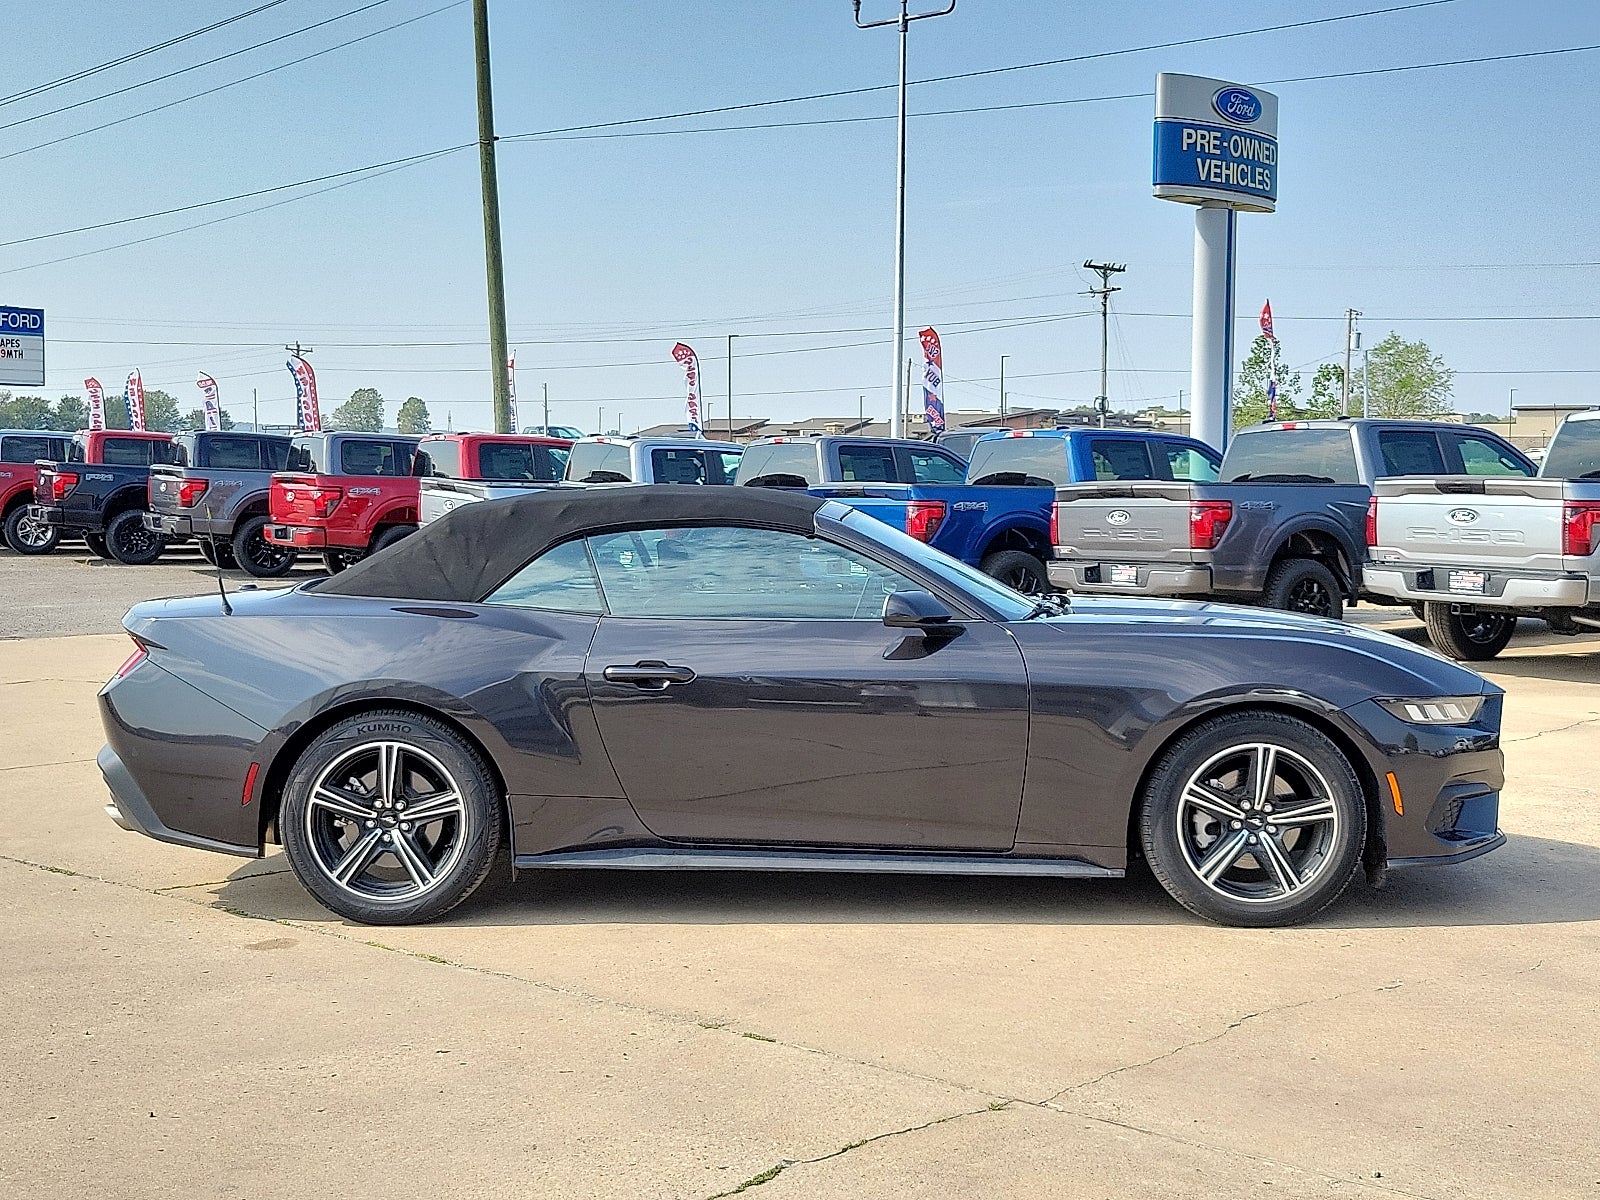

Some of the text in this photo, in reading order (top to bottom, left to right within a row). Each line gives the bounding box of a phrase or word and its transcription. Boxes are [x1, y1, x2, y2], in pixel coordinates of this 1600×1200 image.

[1227, 93, 1255, 117] Ford
[1182, 128, 1276, 165] PRE-OWNED
[1196, 158, 1271, 191] VEHICLES
[0, 312, 41, 329] FORD
[1405, 526, 1526, 545] F-150
[357, 724, 412, 735] KUMHO
